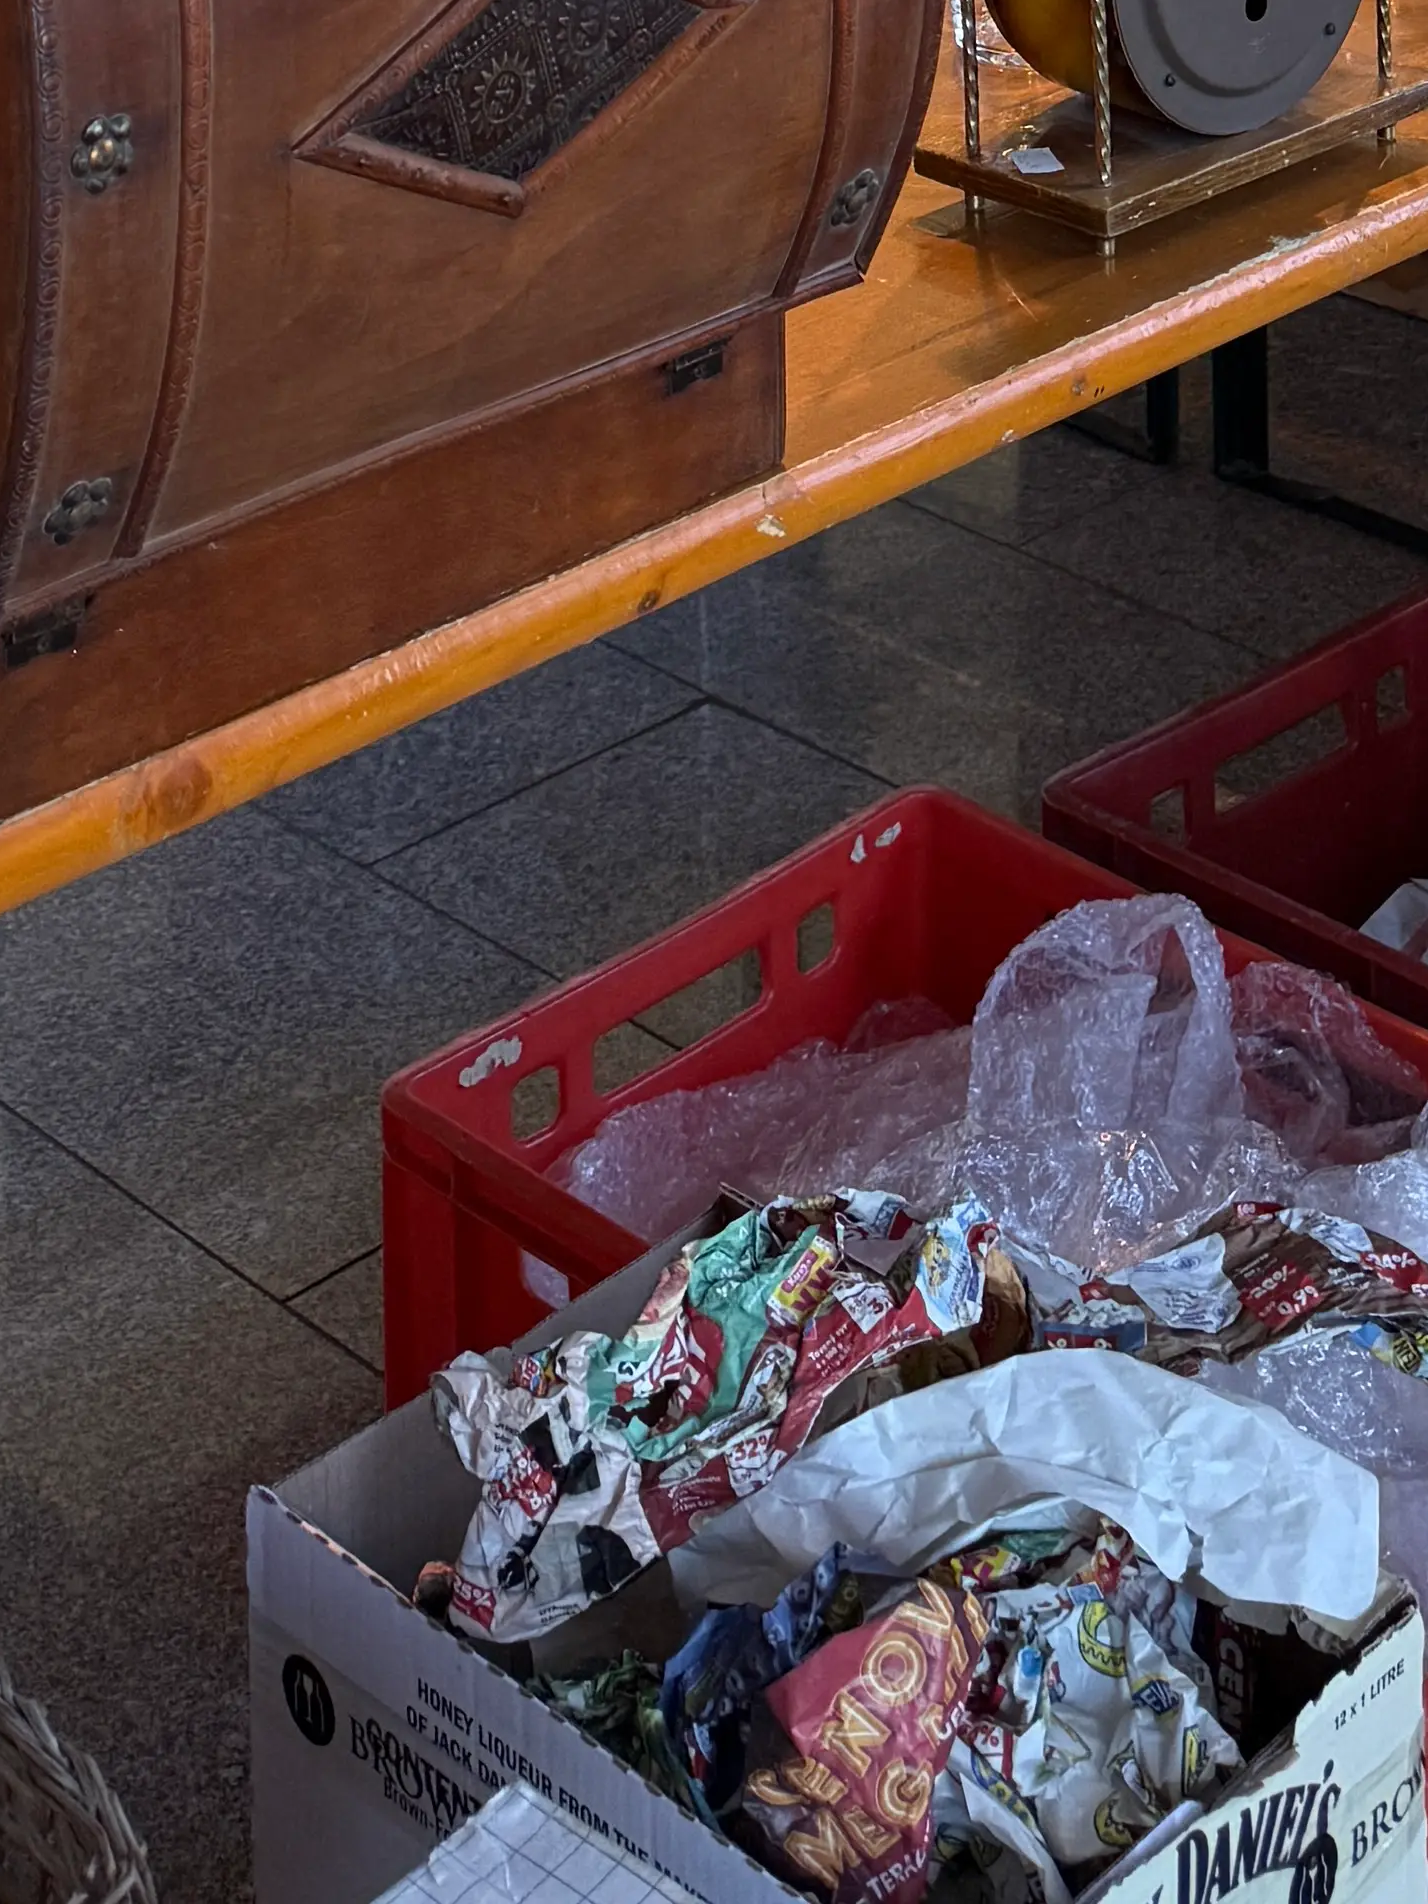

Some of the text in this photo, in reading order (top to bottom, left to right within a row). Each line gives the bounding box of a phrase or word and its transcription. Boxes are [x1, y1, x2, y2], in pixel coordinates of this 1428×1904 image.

[1332, 1657, 1406, 1732] 12 x 1 LITRE
[406, 1704, 428, 1731] OF
[432, 1728, 476, 1774] JACK
[416, 1676, 474, 1736] HONEY
[478, 1724, 554, 1801] LIQUEUR
[559, 1785, 610, 1839] FROM
